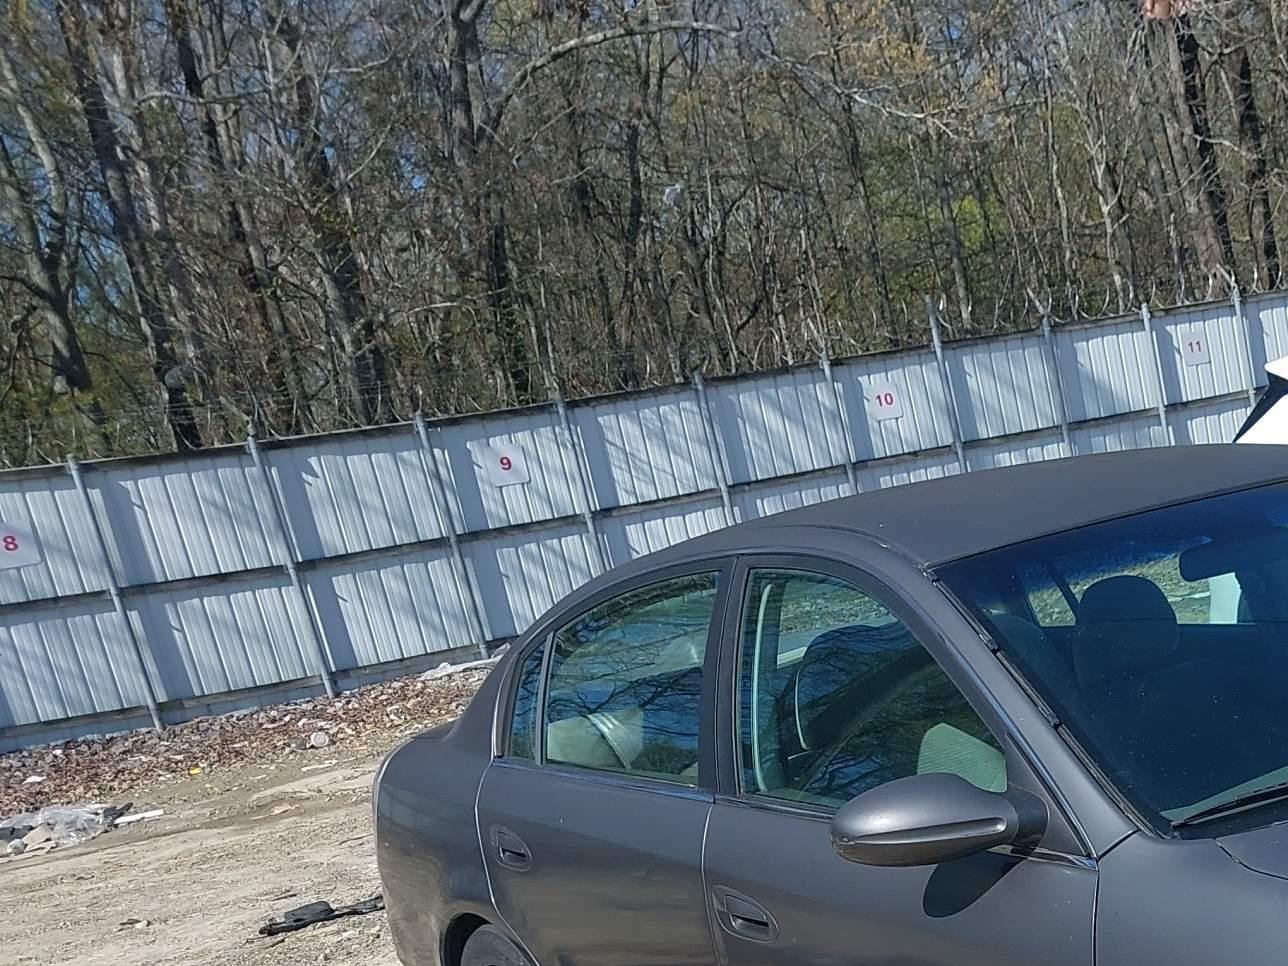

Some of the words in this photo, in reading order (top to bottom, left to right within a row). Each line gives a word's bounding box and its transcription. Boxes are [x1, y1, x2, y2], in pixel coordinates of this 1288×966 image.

[1187, 340, 1202, 353] 11
[875, 392, 894, 408] 10
[499, 456, 513, 471] 9
[2, 535, 19, 552] 8
